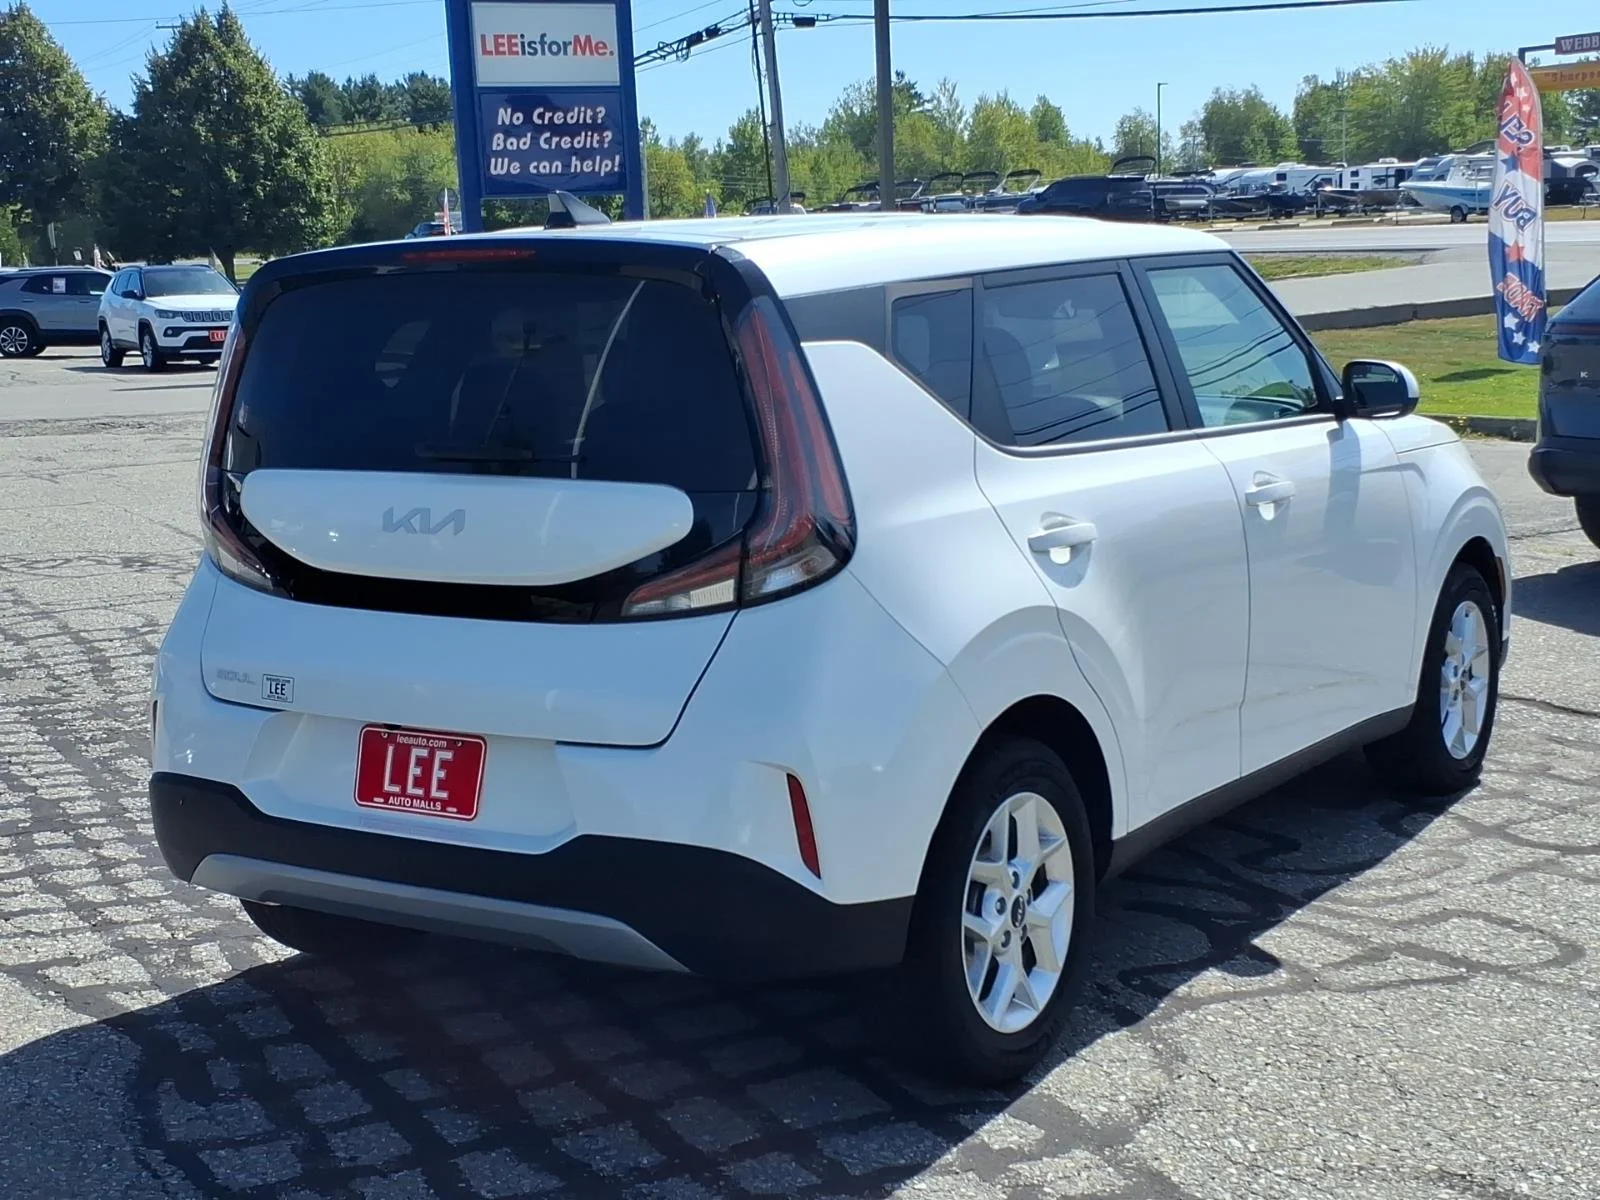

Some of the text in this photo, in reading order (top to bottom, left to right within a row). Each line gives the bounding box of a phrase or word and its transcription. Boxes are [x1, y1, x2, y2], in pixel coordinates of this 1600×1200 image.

[480, 32, 615, 57] LEEisforMe.
[497, 106, 606, 126] No Credit?
[492, 131, 613, 151] Bad Credit?
[490, 155, 620, 177] We can help!
[382, 506, 466, 536] KIA
[269, 680, 286, 696] LEE
[396, 734, 447, 748] leeauto.com
[383, 743, 454, 800] LEE
[388, 795, 442, 811] AUTO MALLS
